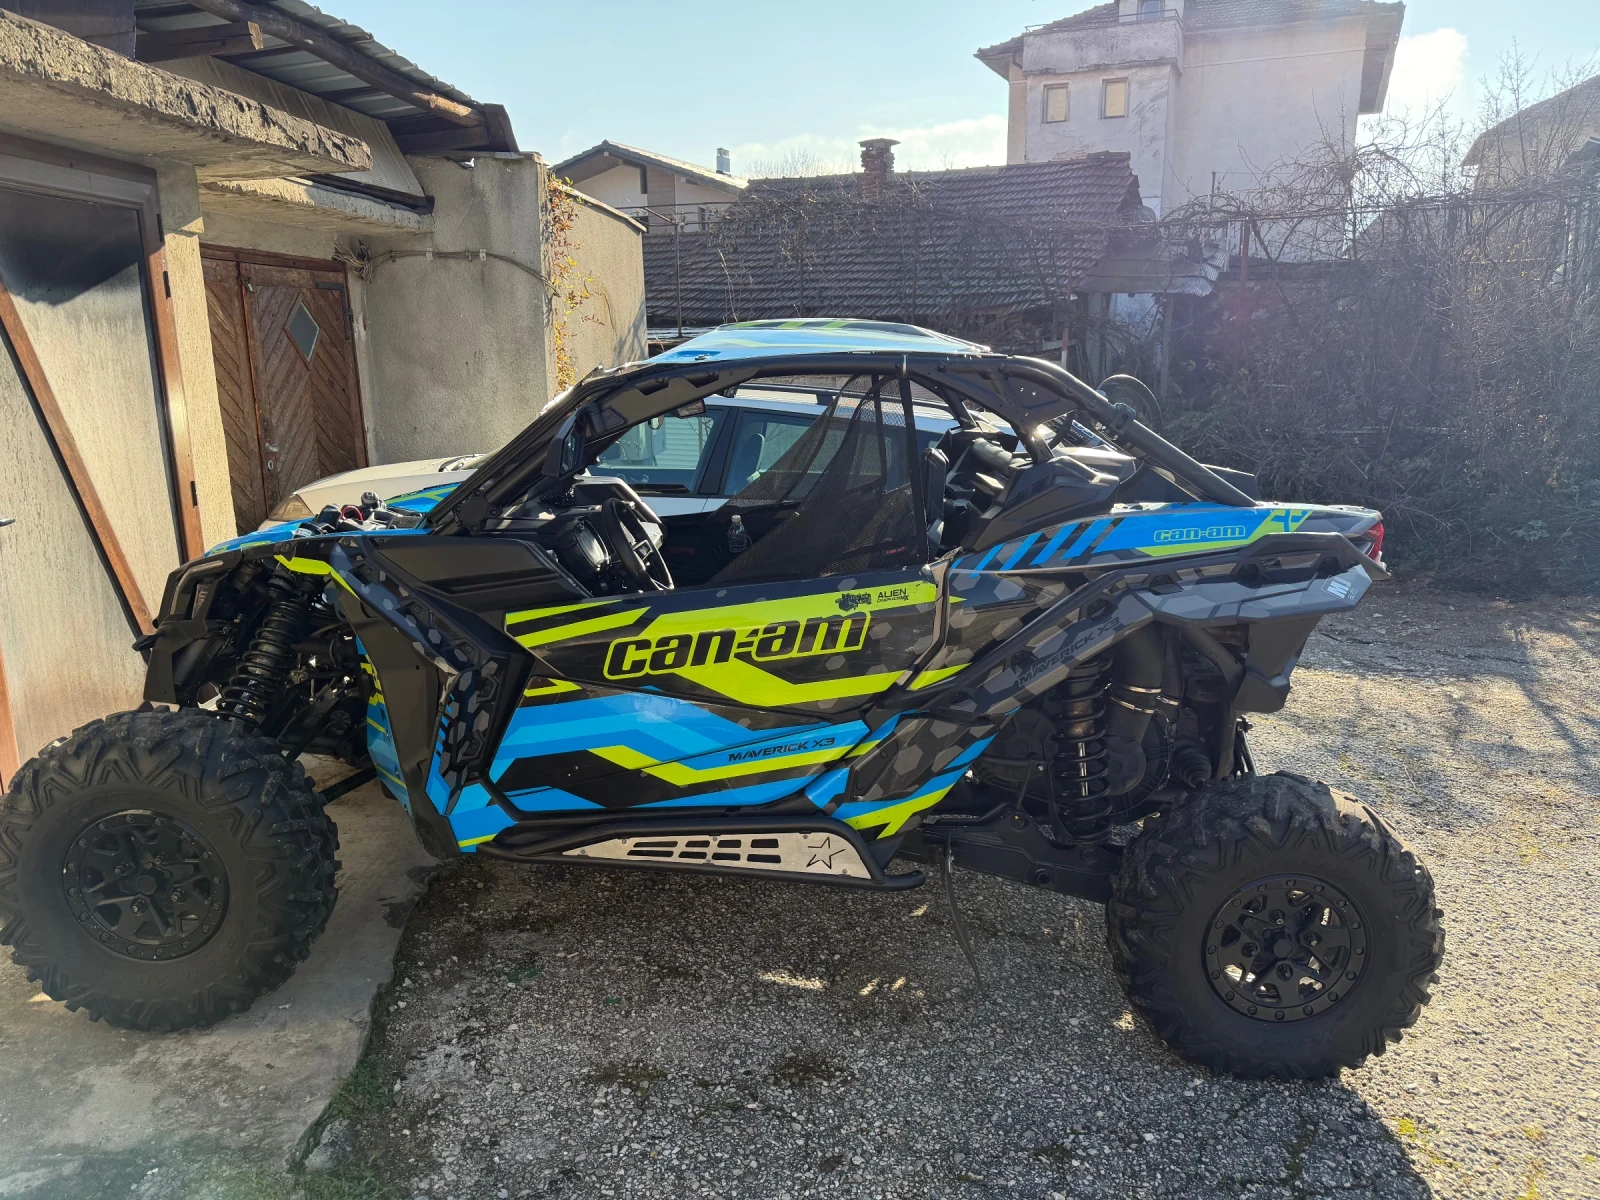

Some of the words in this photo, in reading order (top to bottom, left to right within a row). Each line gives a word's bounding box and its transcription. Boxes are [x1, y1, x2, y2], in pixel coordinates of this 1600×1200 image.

[1154, 525, 1246, 542] can-am
[878, 588, 907, 598] ALIEN
[605, 611, 870, 679] can-am
[1018, 631, 1095, 687] MAVERICK
[1097, 617, 1120, 636] X3
[728, 741, 808, 762] MAVERICK
[812, 737, 836, 749] X3
